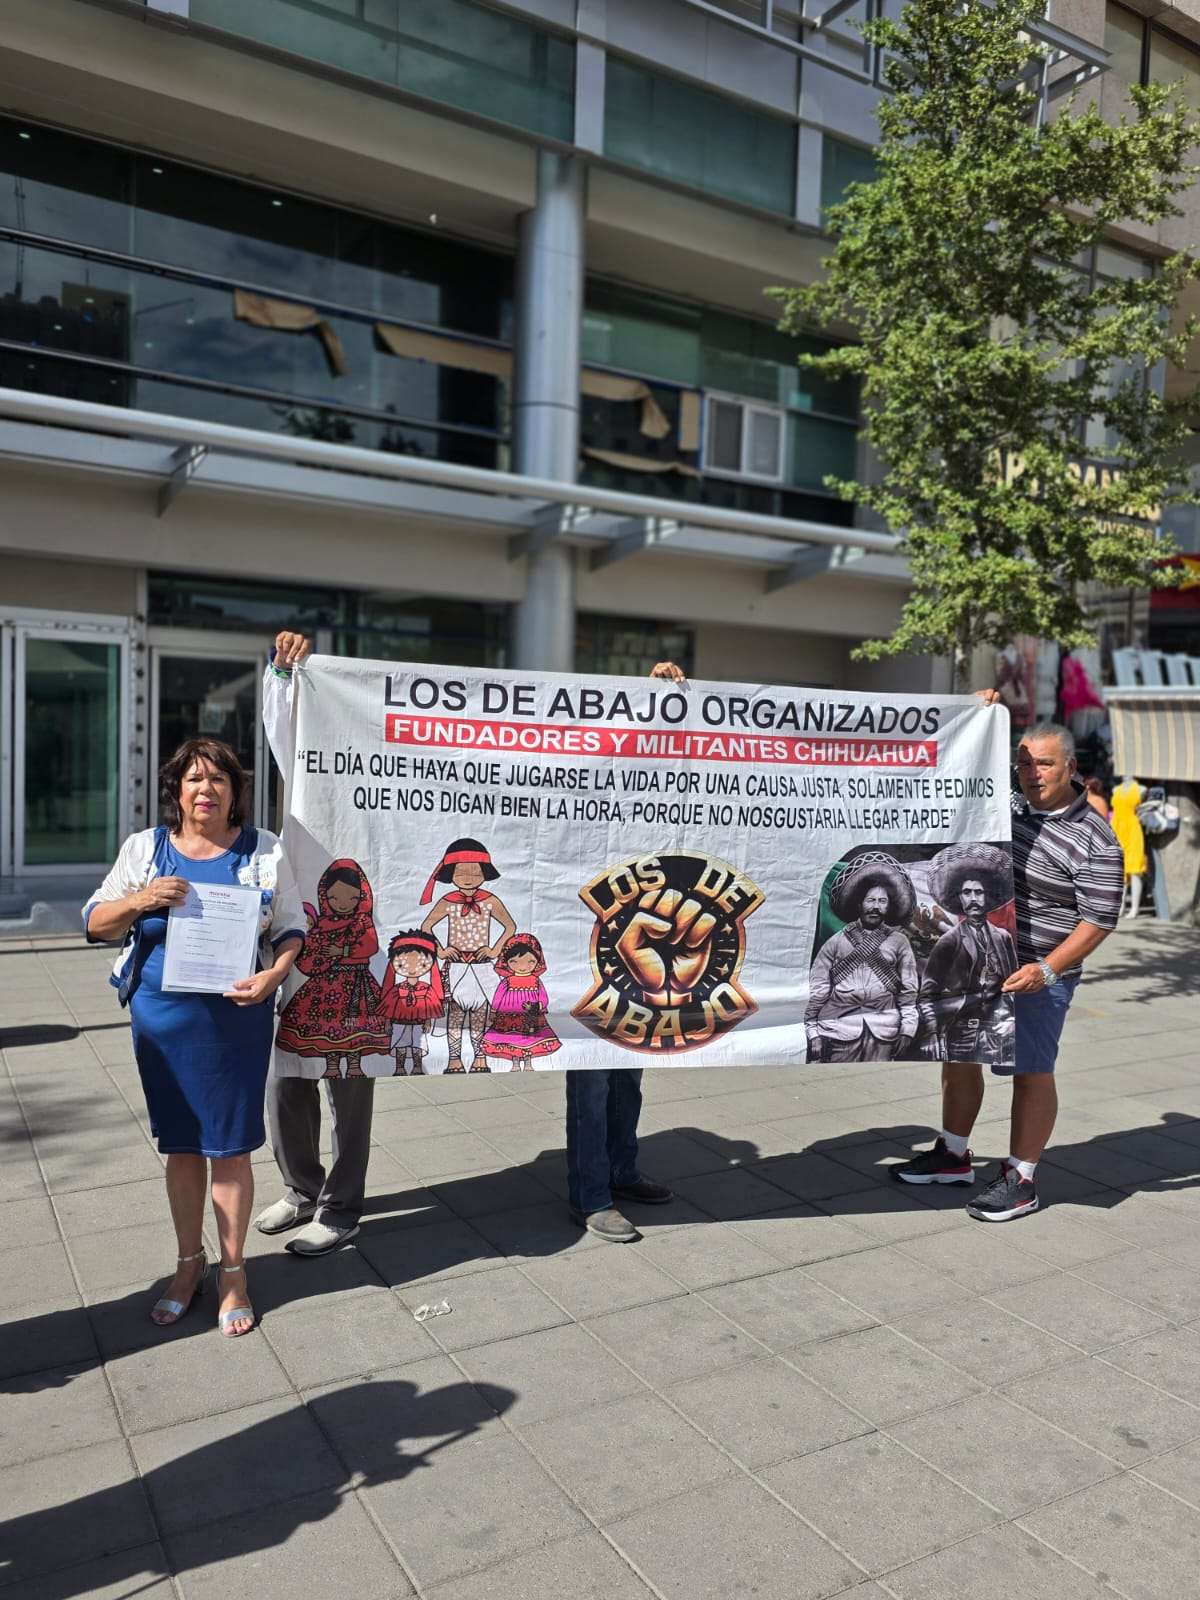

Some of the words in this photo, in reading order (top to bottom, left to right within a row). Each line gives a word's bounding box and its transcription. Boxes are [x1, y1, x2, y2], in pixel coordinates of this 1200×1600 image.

[385, 676, 466, 711] LOS
[483, 683, 535, 716] DE
[547, 688, 687, 723] ABAJO
[702, 696, 940, 734] ORGANIZADOS
[395, 719, 600, 751] FUNDADORES
[609, 733, 628, 752] Y
[637, 735, 787, 759] MILITANTES
[795, 742, 929, 763] CHIHUAHUA
[335, 747, 364, 775] DÍA
[370, 754, 406, 777] QUE
[413, 758, 458, 781] HAYA
[464, 762, 500, 784] QUE
[506, 765, 589, 789] JUGARSE
[595, 770, 615, 790] LA
[622, 770, 660, 792] VIDA
[665, 772, 700, 793] POR
[706, 773, 740, 795] UNA
[746, 775, 798, 797] CAUSA
[801, 777, 845, 800] JUSTA,
[848, 778, 930, 798] SOLAMENTE
[935, 778, 993, 798] PEDIMOS
[354, 787, 391, 810] QUE
[397, 789, 434, 811] NOS
[441, 791, 495, 815] DIGAN
[502, 796, 540, 818] BIEN
[547, 799, 568, 819] LA
[574, 800, 625, 825] HORA,
[633, 802, 703, 825] PORQUE
[709, 805, 732, 825] NO
[848, 809, 899, 829] LLEGAR
[579, 857, 666, 922] LOS
[694, 859, 766, 922] DE
[571, 982, 758, 1047] ABAJO
